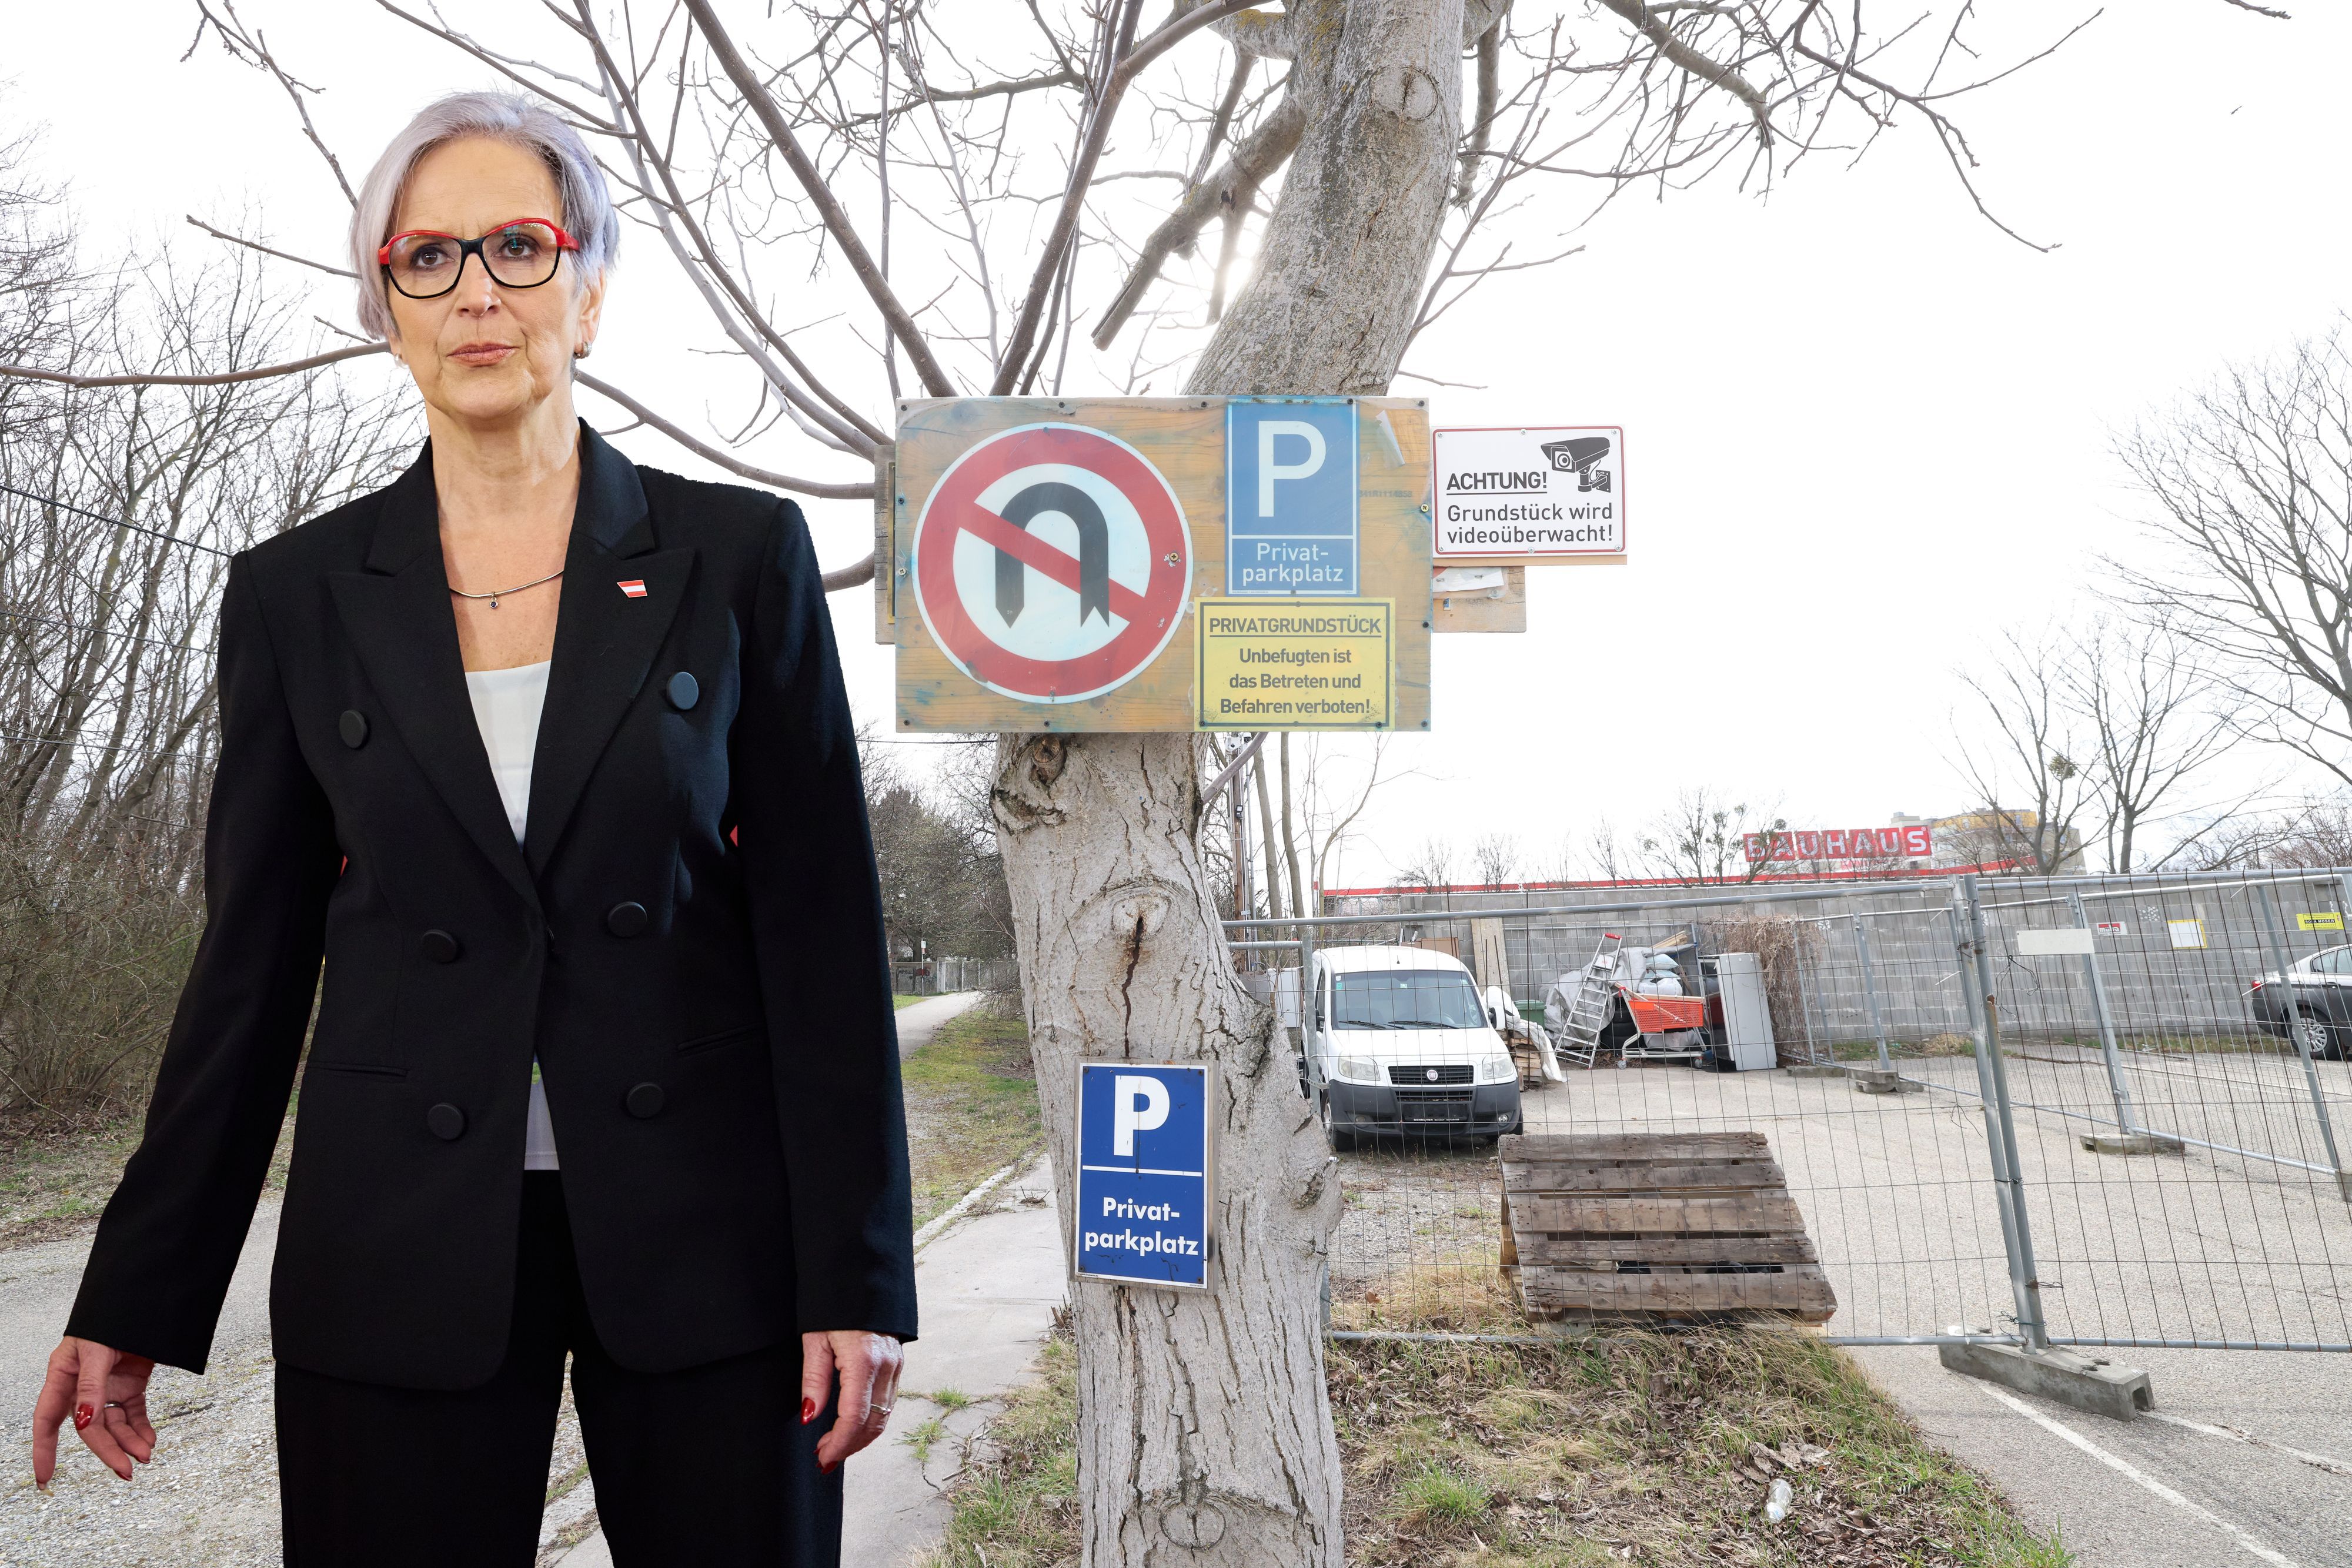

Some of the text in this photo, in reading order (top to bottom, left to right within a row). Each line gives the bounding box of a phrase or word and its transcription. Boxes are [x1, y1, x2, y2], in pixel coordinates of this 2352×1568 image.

[1258, 420, 1327, 517] P
[1446, 471, 1547, 490] ACHTUNG!
[1448, 502, 1612, 522] Grundstück wird
[1447, 524, 1612, 544] videoüberwacht!
[1257, 543, 1329, 561] Privat-
[1242, 563, 1344, 587] parkplatz
[1210, 614, 1381, 634] PRIVATGRUNDSTÜCK
[1240, 648, 1352, 667] Unbefugten ist
[1230, 673, 1361, 688] das Betreten und
[1221, 698, 1370, 713] Befahren verboten!
[1746, 830, 1927, 858] BAUHAUS
[1114, 1075, 1170, 1156] P
[1103, 1196, 1180, 1221] Privat-
[1085, 1228, 1199, 1257] parkplatz
